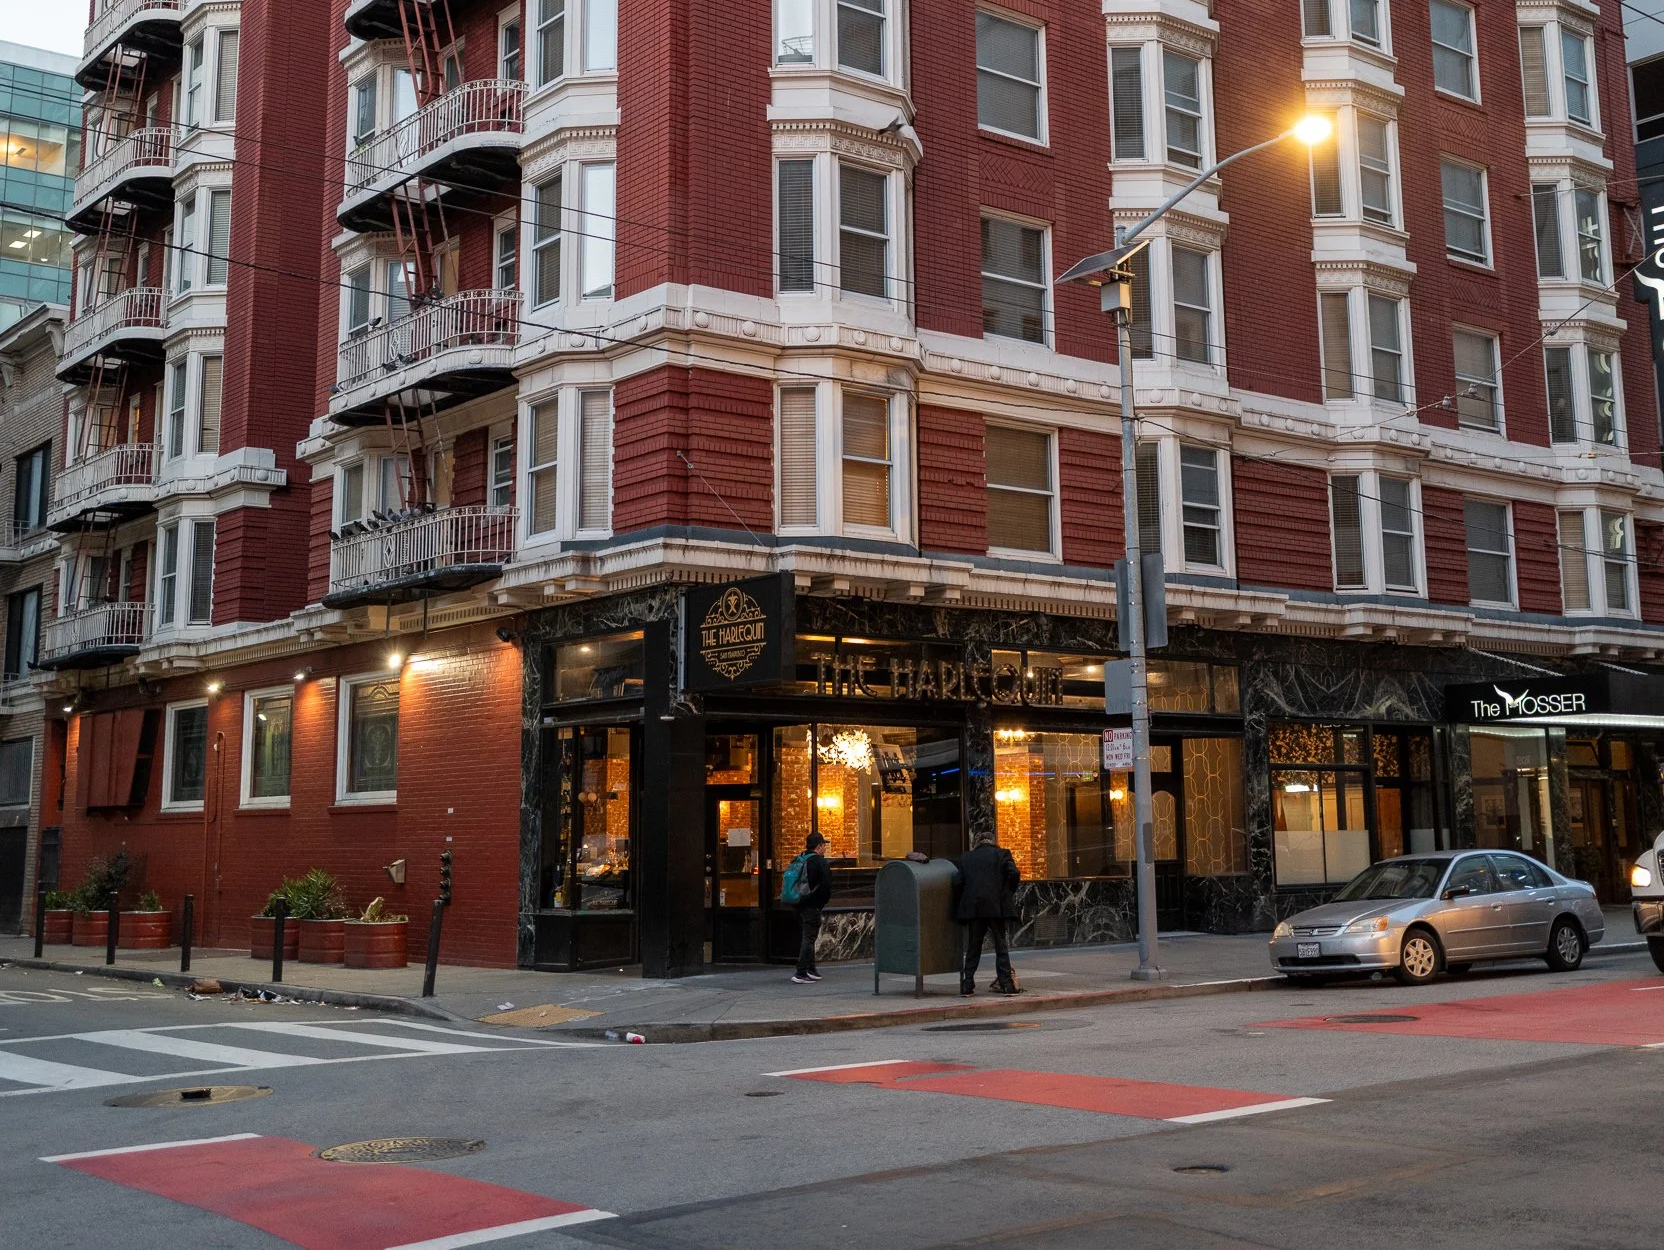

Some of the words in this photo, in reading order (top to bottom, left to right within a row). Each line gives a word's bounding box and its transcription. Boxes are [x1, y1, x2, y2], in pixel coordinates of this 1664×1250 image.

[702, 629, 717, 647] THE
[719, 622, 765, 644] HARLEQUIN
[816, 653, 878, 698] THE
[889, 657, 1064, 706] HARLEQUIN
[1470, 701, 1501, 718] The
[1104, 731, 1112, 742] NO
